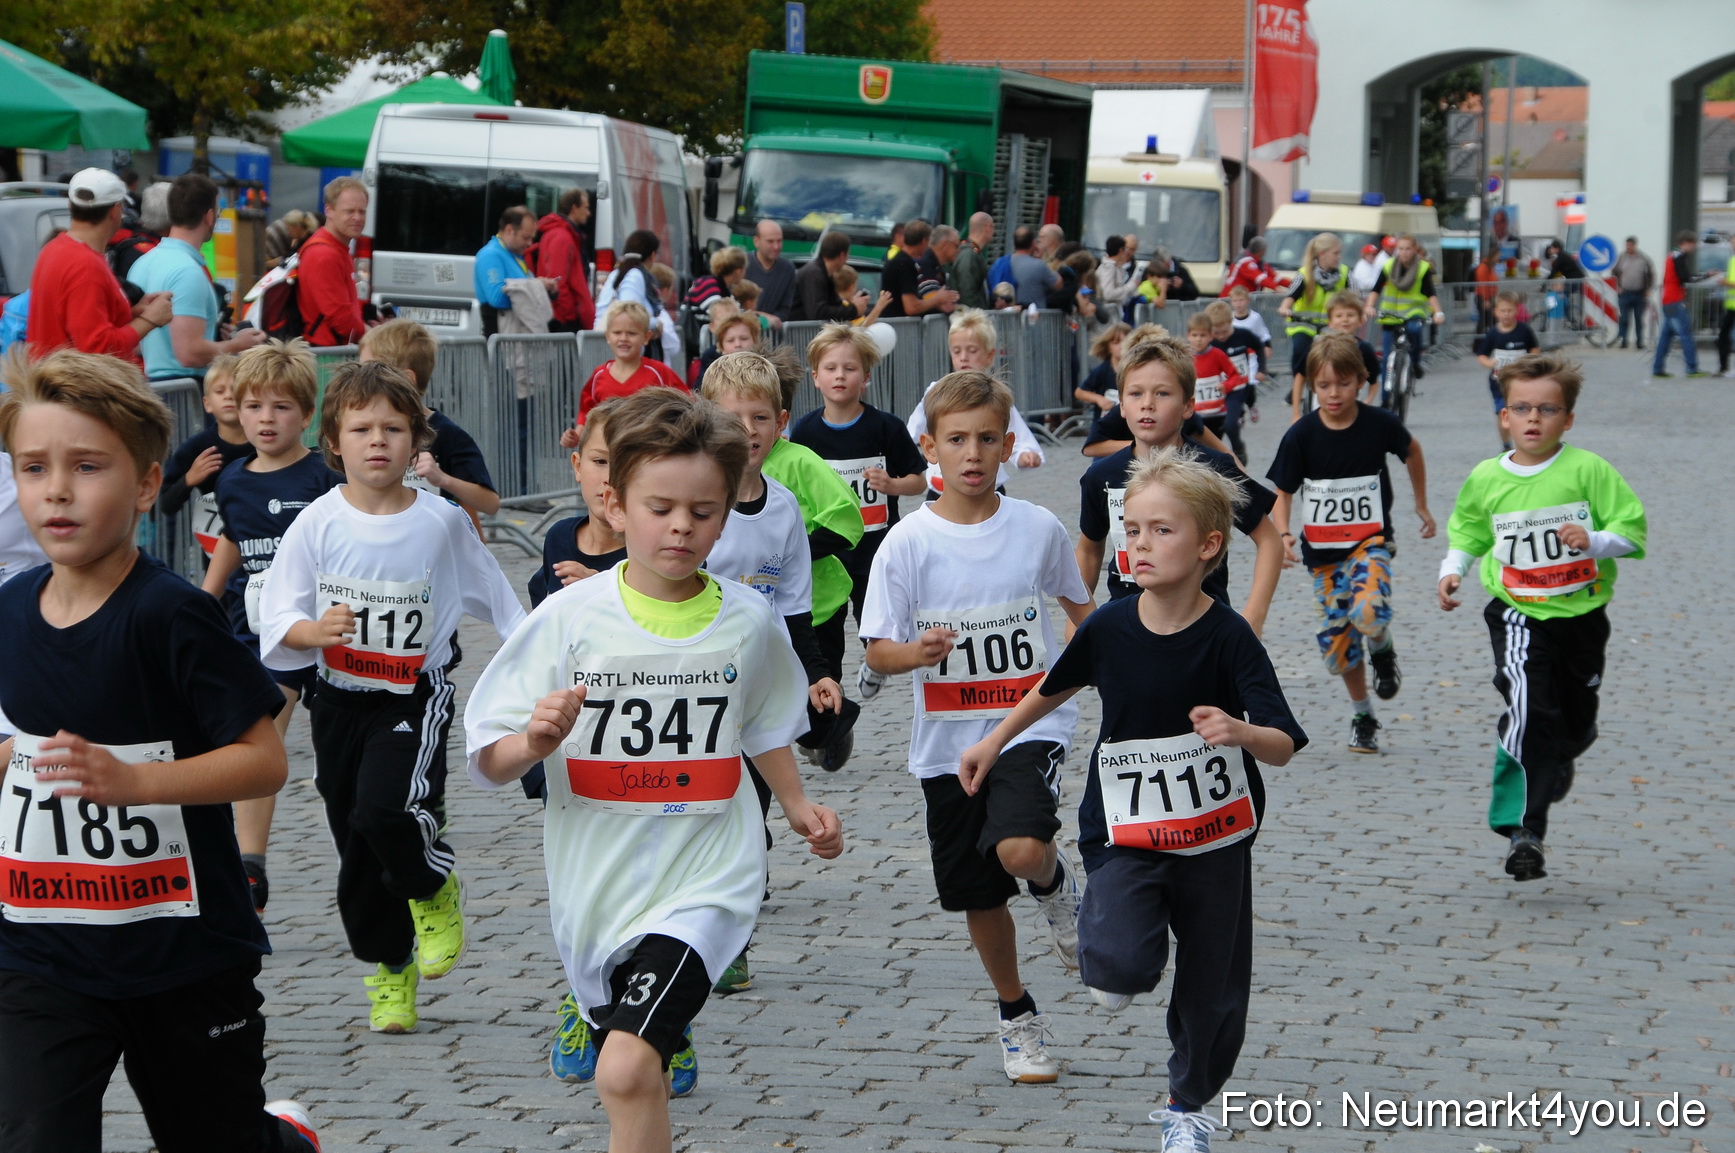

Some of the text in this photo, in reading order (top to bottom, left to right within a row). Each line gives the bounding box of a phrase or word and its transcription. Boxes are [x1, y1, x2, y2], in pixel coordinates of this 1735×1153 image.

[790, 10, 801, 48] P
[1258, 4, 1301, 31] 175
[1258, 25, 1300, 46] JAHRE
[1328, 485, 1367, 494] Neumarkt
[1310, 496, 1372, 523] 7296
[1496, 513, 1575, 532] PARTL Neumarkt
[740, 575, 753, 585] 14
[1518, 568, 1581, 586] Johannes
[319, 583, 419, 605] PARTL Neumarkt
[331, 601, 423, 650] 112
[960, 613, 1021, 632] Neumarkt
[344, 652, 411, 680] Dominik
[573, 670, 719, 687] PARTL Neumarkt
[960, 686, 1018, 706] Moritz
[583, 696, 729, 757] 7347
[1101, 744, 1217, 768] PARTL Neumarkt
[608, 763, 671, 797] Jakob
[1117, 755, 1232, 817] 7113
[663, 803, 688, 814] 2005
[12, 785, 160, 860] 7185
[1147, 816, 1223, 848] Vincent
[169, 843, 182, 855] M
[9, 869, 169, 902] Maximilian
[222, 1019, 247, 1032] JAKO
